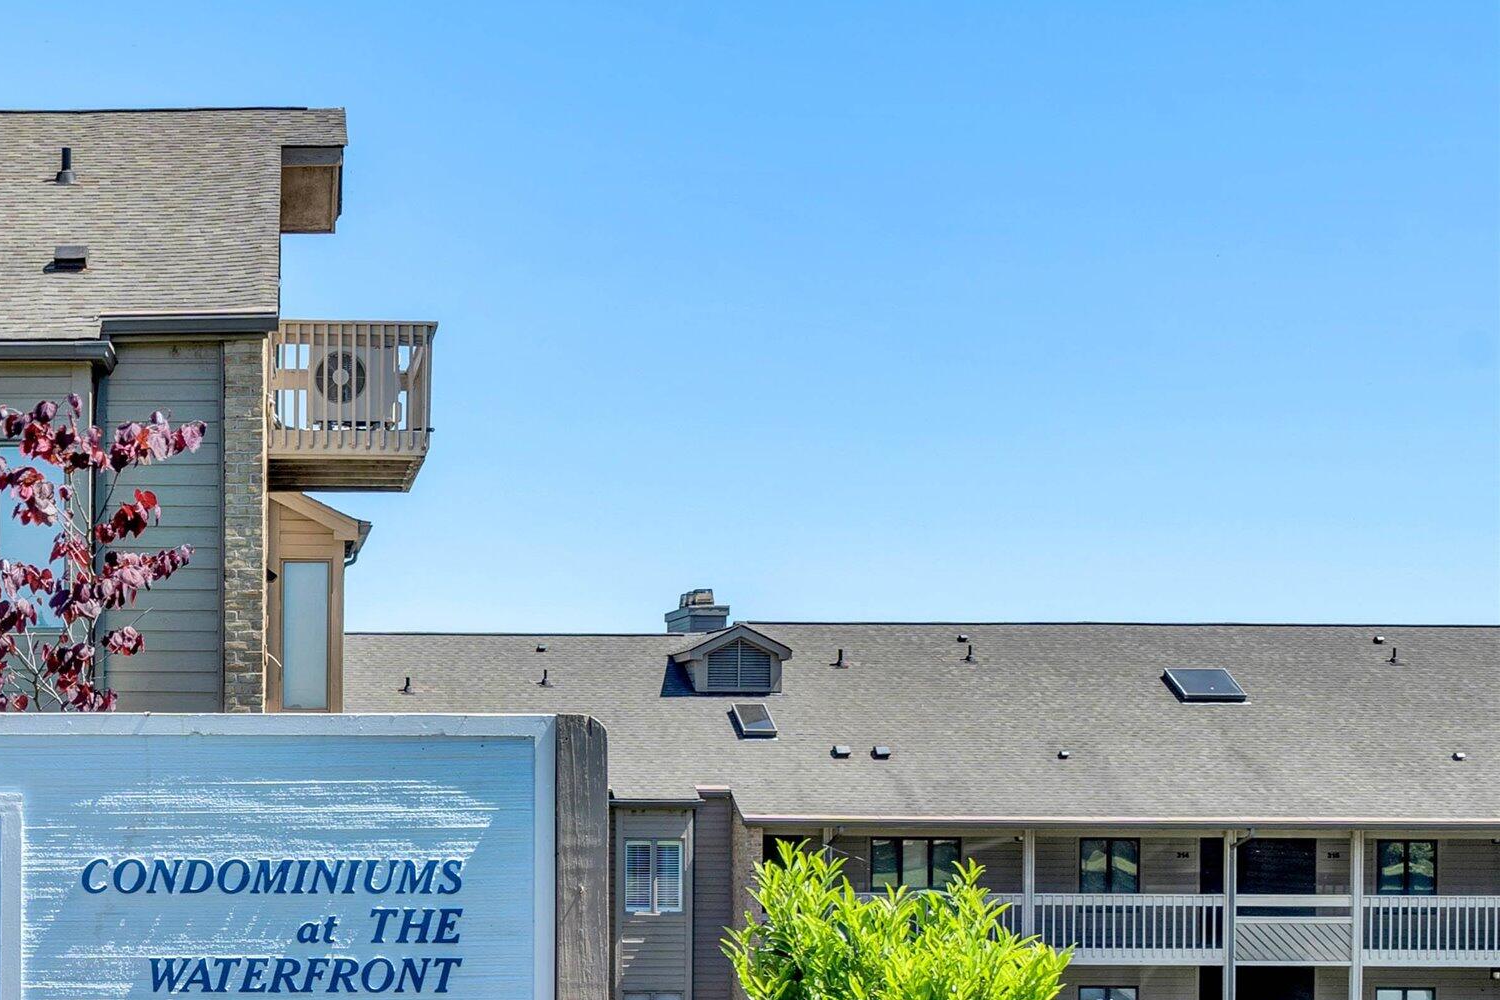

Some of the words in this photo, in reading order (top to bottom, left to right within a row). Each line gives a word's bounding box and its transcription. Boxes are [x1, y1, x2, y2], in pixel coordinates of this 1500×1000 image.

[81, 858, 464, 895] CONDOMINIUMS
[296, 916, 338, 945] at
[370, 908, 464, 944] THE
[148, 957, 464, 994] WATERFRONT
